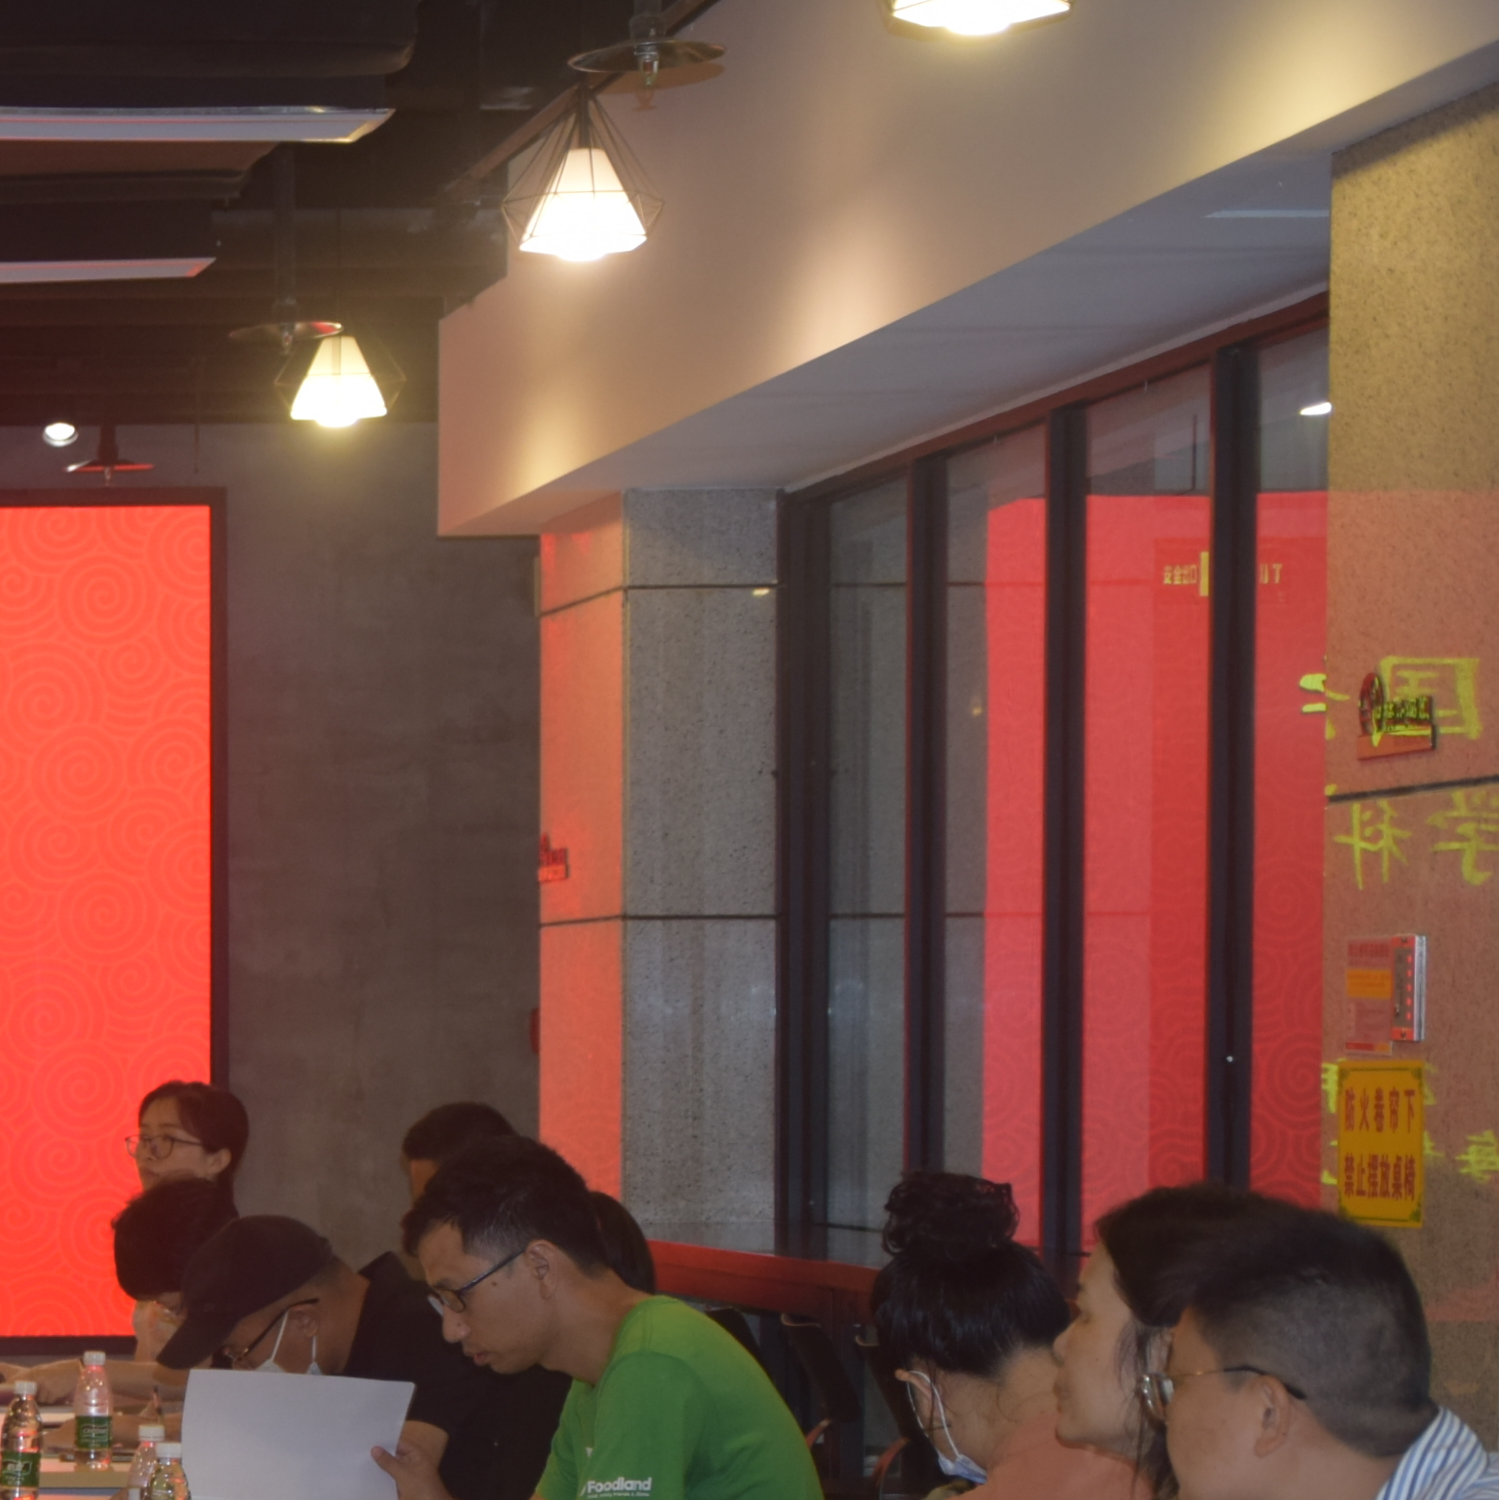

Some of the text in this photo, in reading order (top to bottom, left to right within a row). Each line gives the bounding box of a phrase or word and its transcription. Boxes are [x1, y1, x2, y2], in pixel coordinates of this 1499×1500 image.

[1344, 1086, 1415, 1133] 防火卷帘下
[1344, 1154, 1415, 1200] 禁止摆放桌椅
[587, 1476, 652, 1493] Foodland
